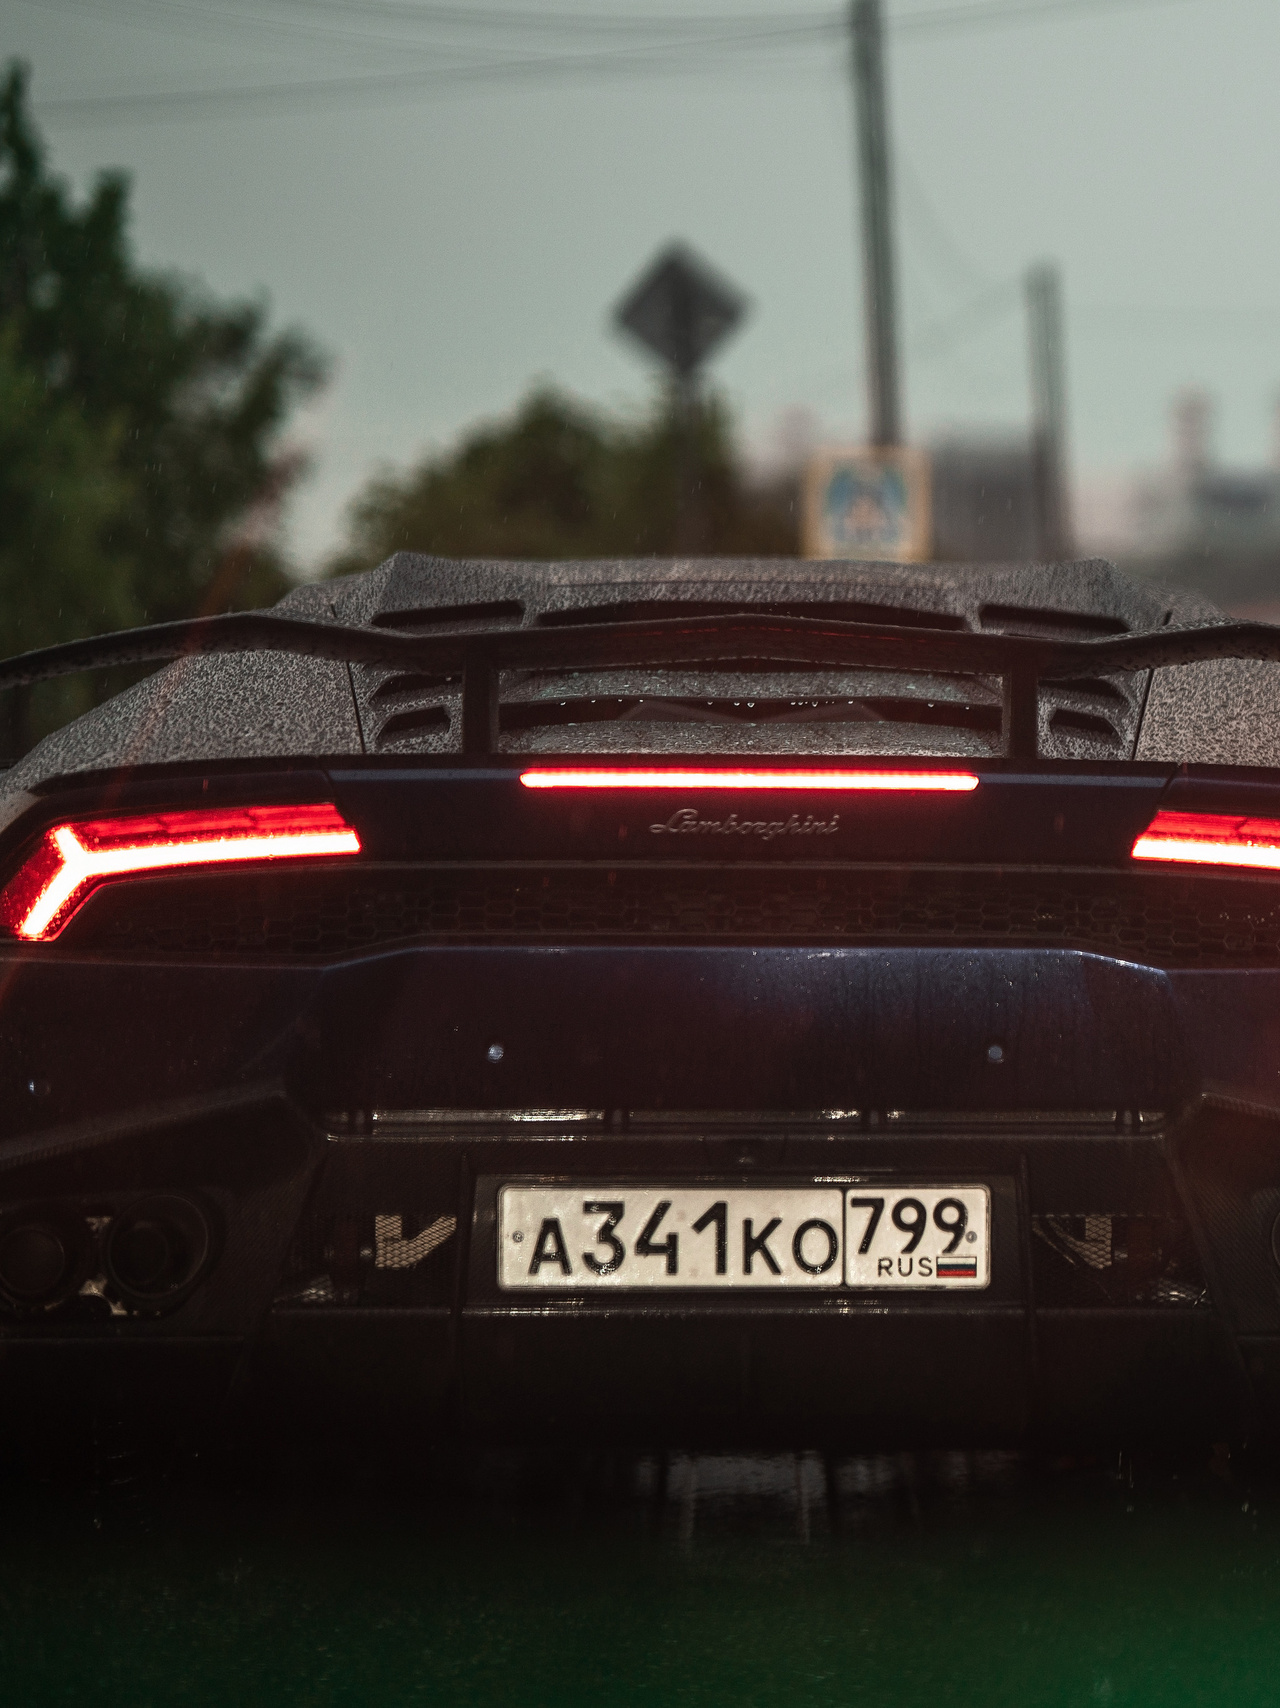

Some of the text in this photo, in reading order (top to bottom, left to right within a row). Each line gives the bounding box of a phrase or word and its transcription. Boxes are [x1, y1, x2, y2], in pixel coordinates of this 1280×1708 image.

[650, 808, 840, 841] Lamborghini
[850, 1198, 968, 1255] 799
[877, 1257, 933, 1278] RUS
